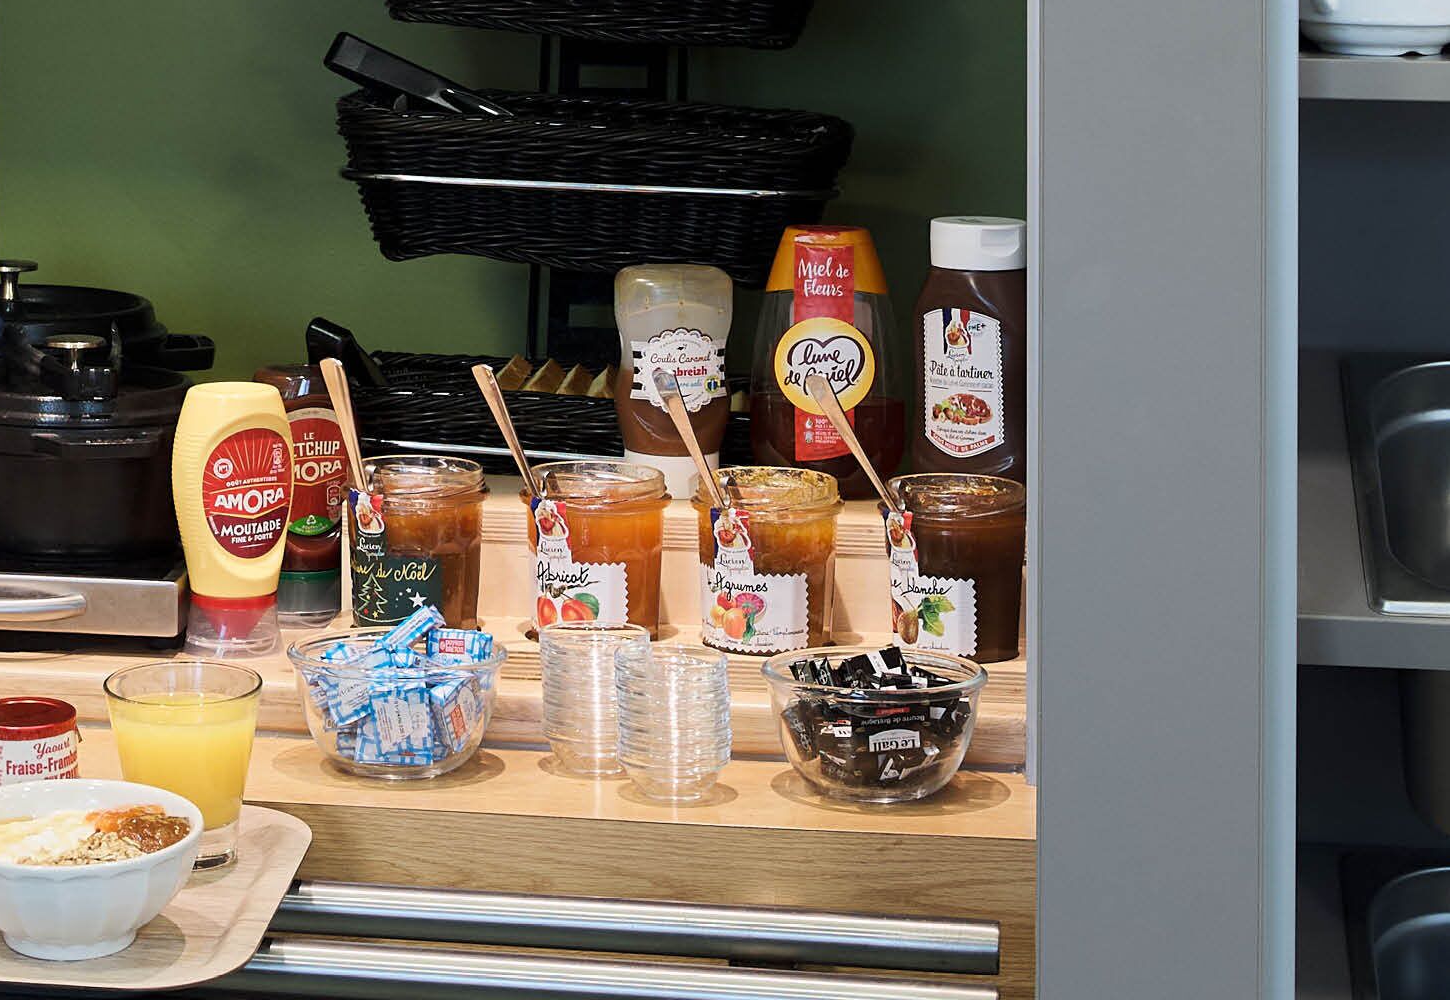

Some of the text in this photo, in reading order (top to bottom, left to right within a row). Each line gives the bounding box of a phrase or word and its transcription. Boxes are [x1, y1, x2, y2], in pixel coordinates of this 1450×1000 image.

[798, 256, 850, 280] Miel de
[803, 279, 844, 297] Fleurs
[650, 351, 711, 364] Coulis Caramel
[784, 368, 801, 387] de
[929, 360, 995, 380] Pâte à tartiner
[303, 432, 315, 441] LE
[214, 487, 285, 514] AMORA
[220, 518, 281, 537] MOUTARDE
[231, 536, 247, 544] FINE
[254, 532, 273, 542] FORTE
[356, 536, 384, 554] Lucien
[716, 553, 746, 568] Lucien
[376, 562, 393, 578] de
[394, 561, 437, 582] Noël
[536, 560, 590, 593] Abricot
[715, 571, 768, 602] Agrumes
[33, 737, 71, 760] Yaourt
[873, 739, 916, 752] Le Gall
